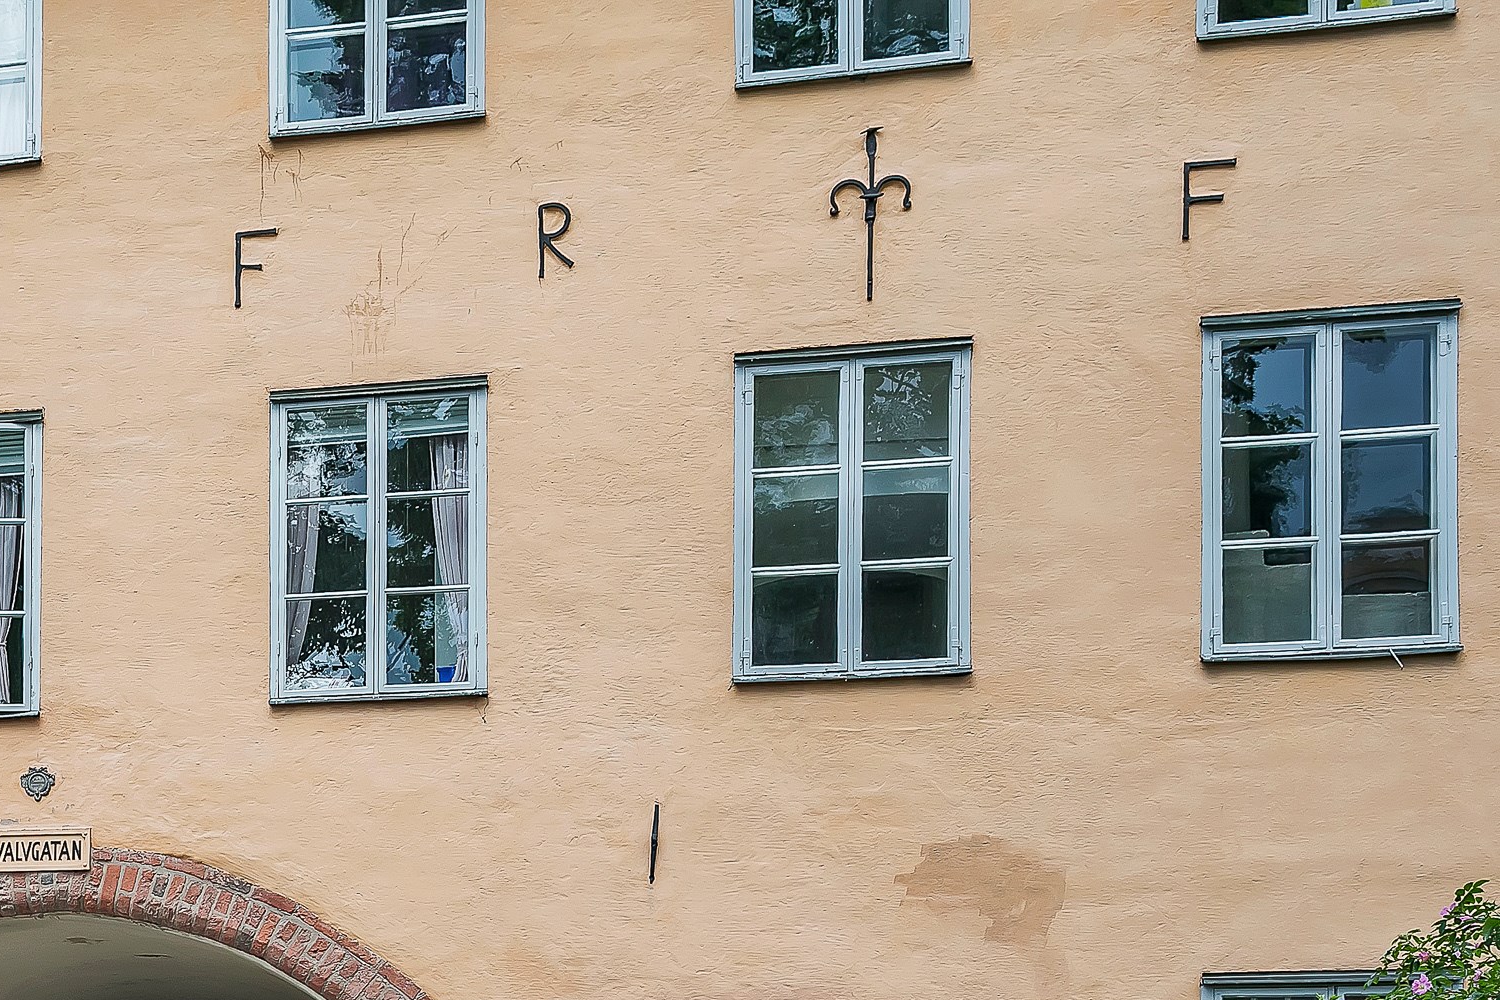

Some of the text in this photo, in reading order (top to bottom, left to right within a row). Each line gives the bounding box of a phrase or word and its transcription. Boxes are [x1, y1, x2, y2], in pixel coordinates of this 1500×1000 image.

[234, 228, 279, 309] F
[537, 202, 575, 279] R
[1181, 157, 1237, 240] F
